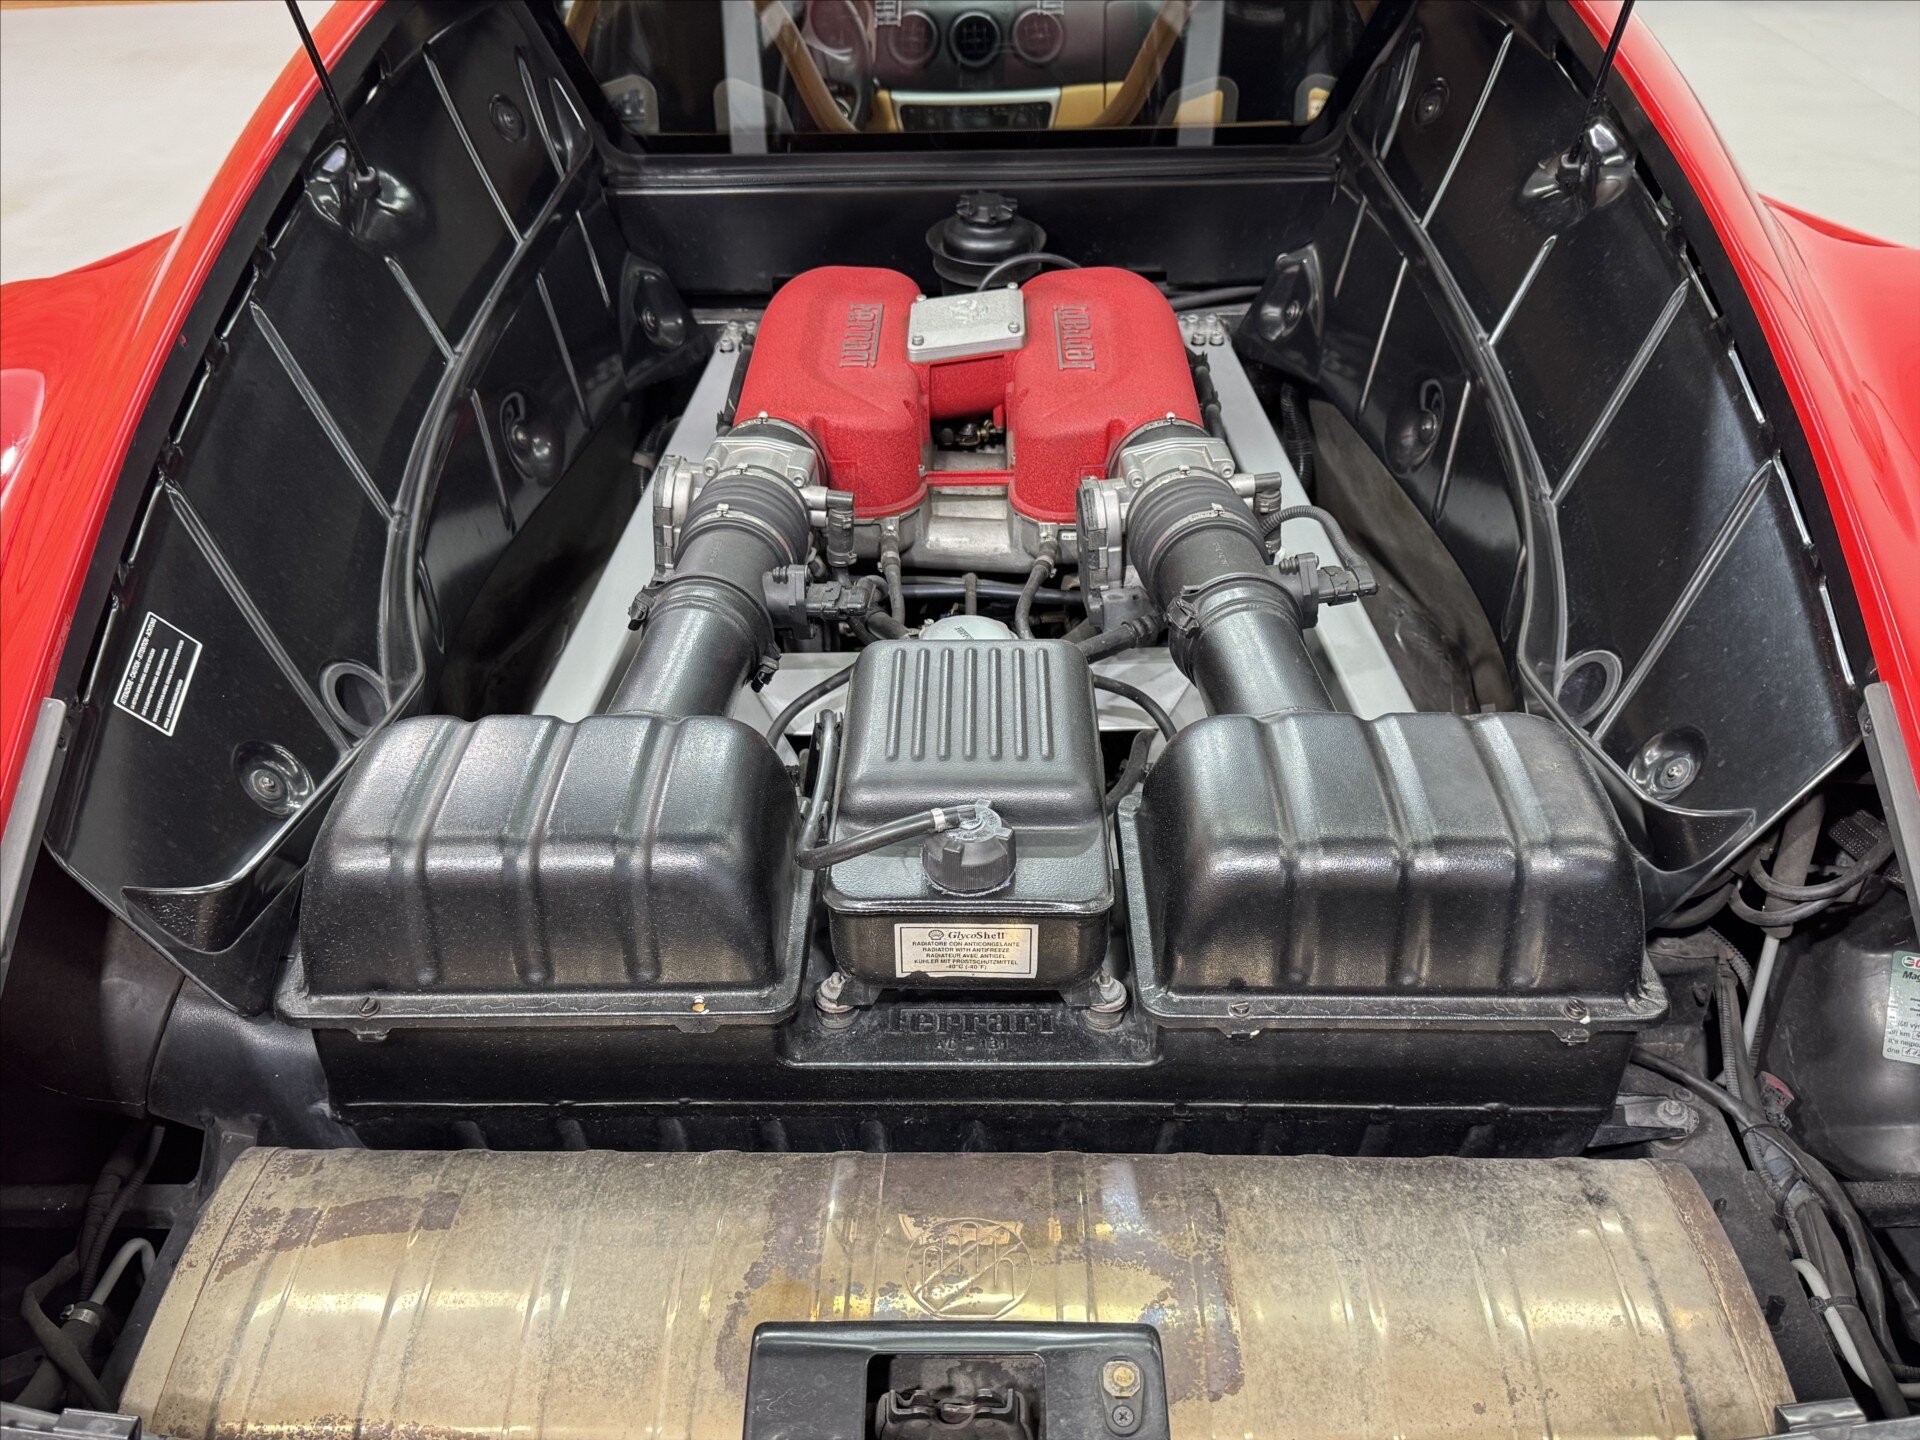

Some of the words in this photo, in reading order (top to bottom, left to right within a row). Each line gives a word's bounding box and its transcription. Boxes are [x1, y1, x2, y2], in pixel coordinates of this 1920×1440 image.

[839, 303, 884, 368] Ferrari
[1053, 304, 1096, 370] Ferrari
[129, 660, 141, 679] CAUTION
[136, 636, 150, 661] ATTENTION
[948, 931, 1005, 940] GlycoShell
[884, 1008, 1054, 1035] Ferrari
